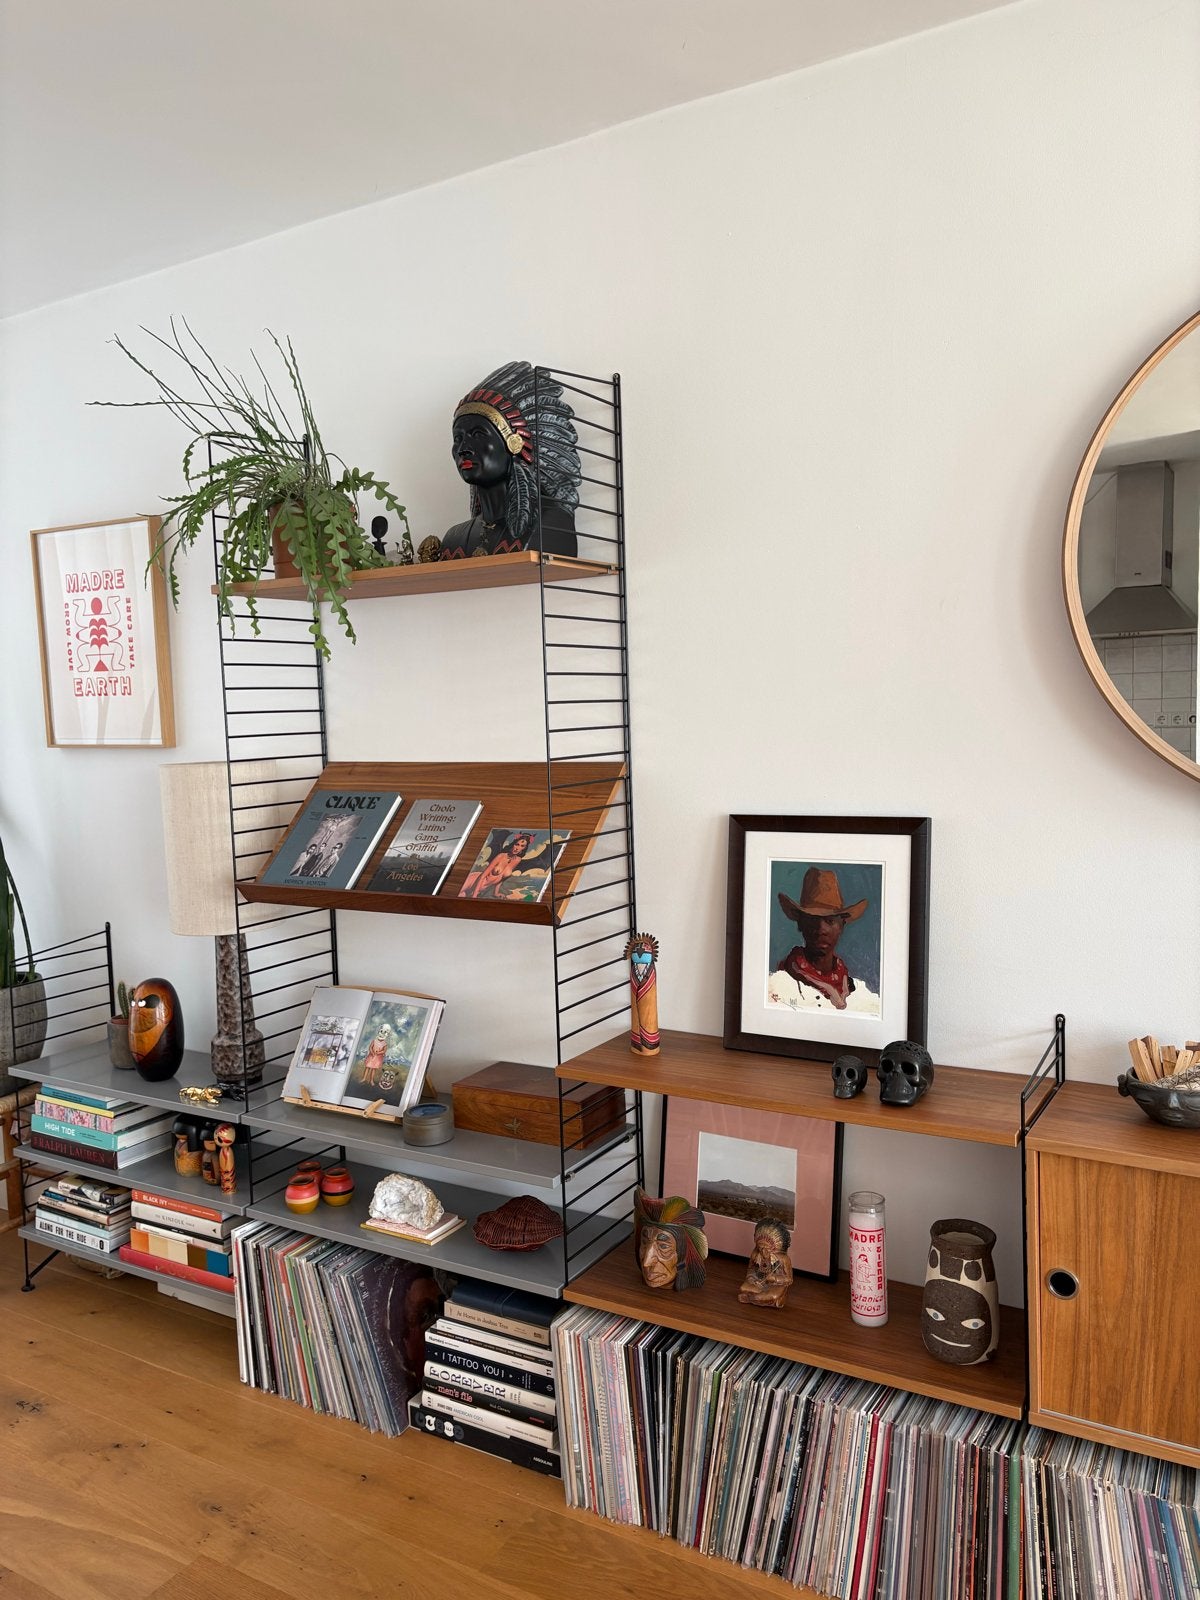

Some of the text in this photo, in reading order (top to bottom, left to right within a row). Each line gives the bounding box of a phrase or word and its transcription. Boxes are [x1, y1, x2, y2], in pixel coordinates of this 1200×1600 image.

[66, 569, 125, 593] MADRE
[73, 676, 132, 696] EARTH
[325, 796, 382, 812] CLIQUE
[430, 804, 456, 812] Cholo
[420, 813, 456, 823] Writing:
[418, 824, 446, 832] Latino
[415, 833, 439, 842] Gang
[406, 844, 438, 852] Graffiti
[386, 872, 424, 882] Angeles
[45, 1122, 76, 1136] HIGH TIDE
[40, 1138, 105, 1163] RALPH LAUREN
[142, 1194, 158, 1203] BLACK
[40, 1221, 53, 1232] ALONG
[66, 1230, 74, 1240] THE
[77, 1234, 87, 1244] RIDE
[849, 1232, 882, 1243] MADRE
[448, 1353, 479, 1370] TATTOO
[482, 1364, 500, 1377] YOU
[430, 1366, 506, 1398] FOREVER
[438, 1385, 460, 1398] men's
[460, 1391, 473, 1402] file
